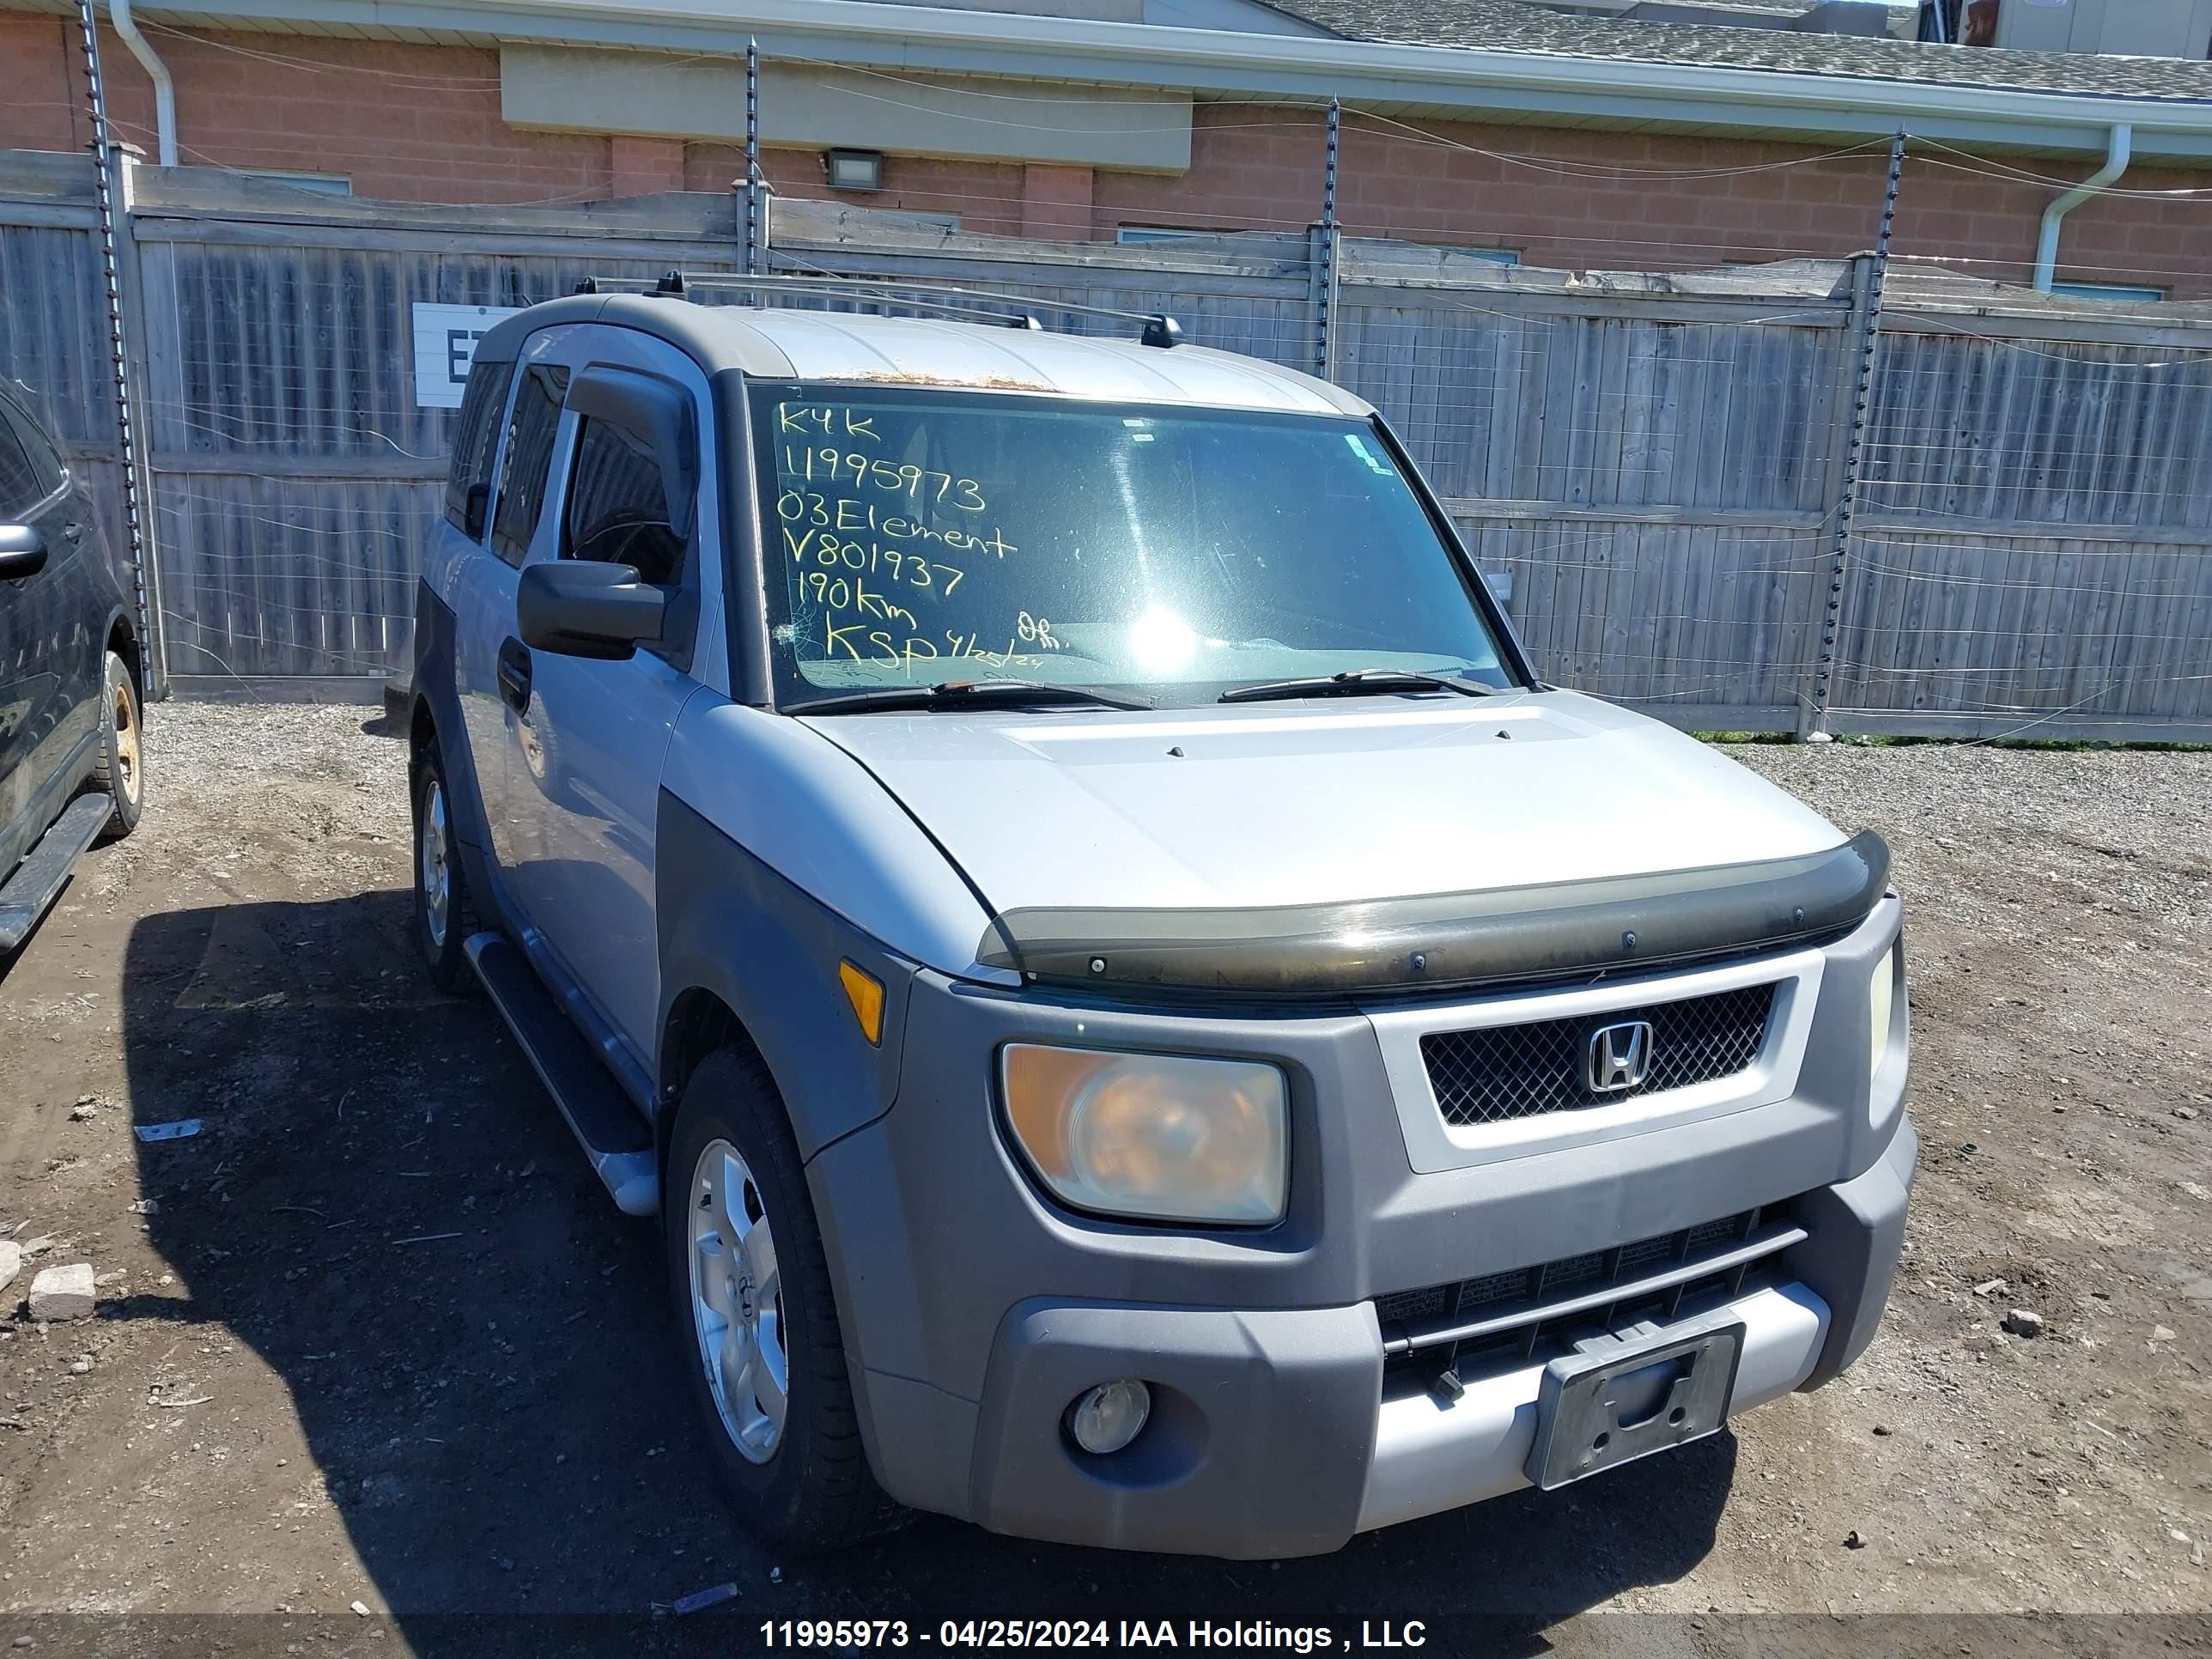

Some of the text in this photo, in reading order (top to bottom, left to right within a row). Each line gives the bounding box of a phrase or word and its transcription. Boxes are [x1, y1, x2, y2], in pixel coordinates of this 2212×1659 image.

[447, 329, 488, 383] E
[785, 445, 986, 511] 11995973
[784, 528, 963, 595] V801937
